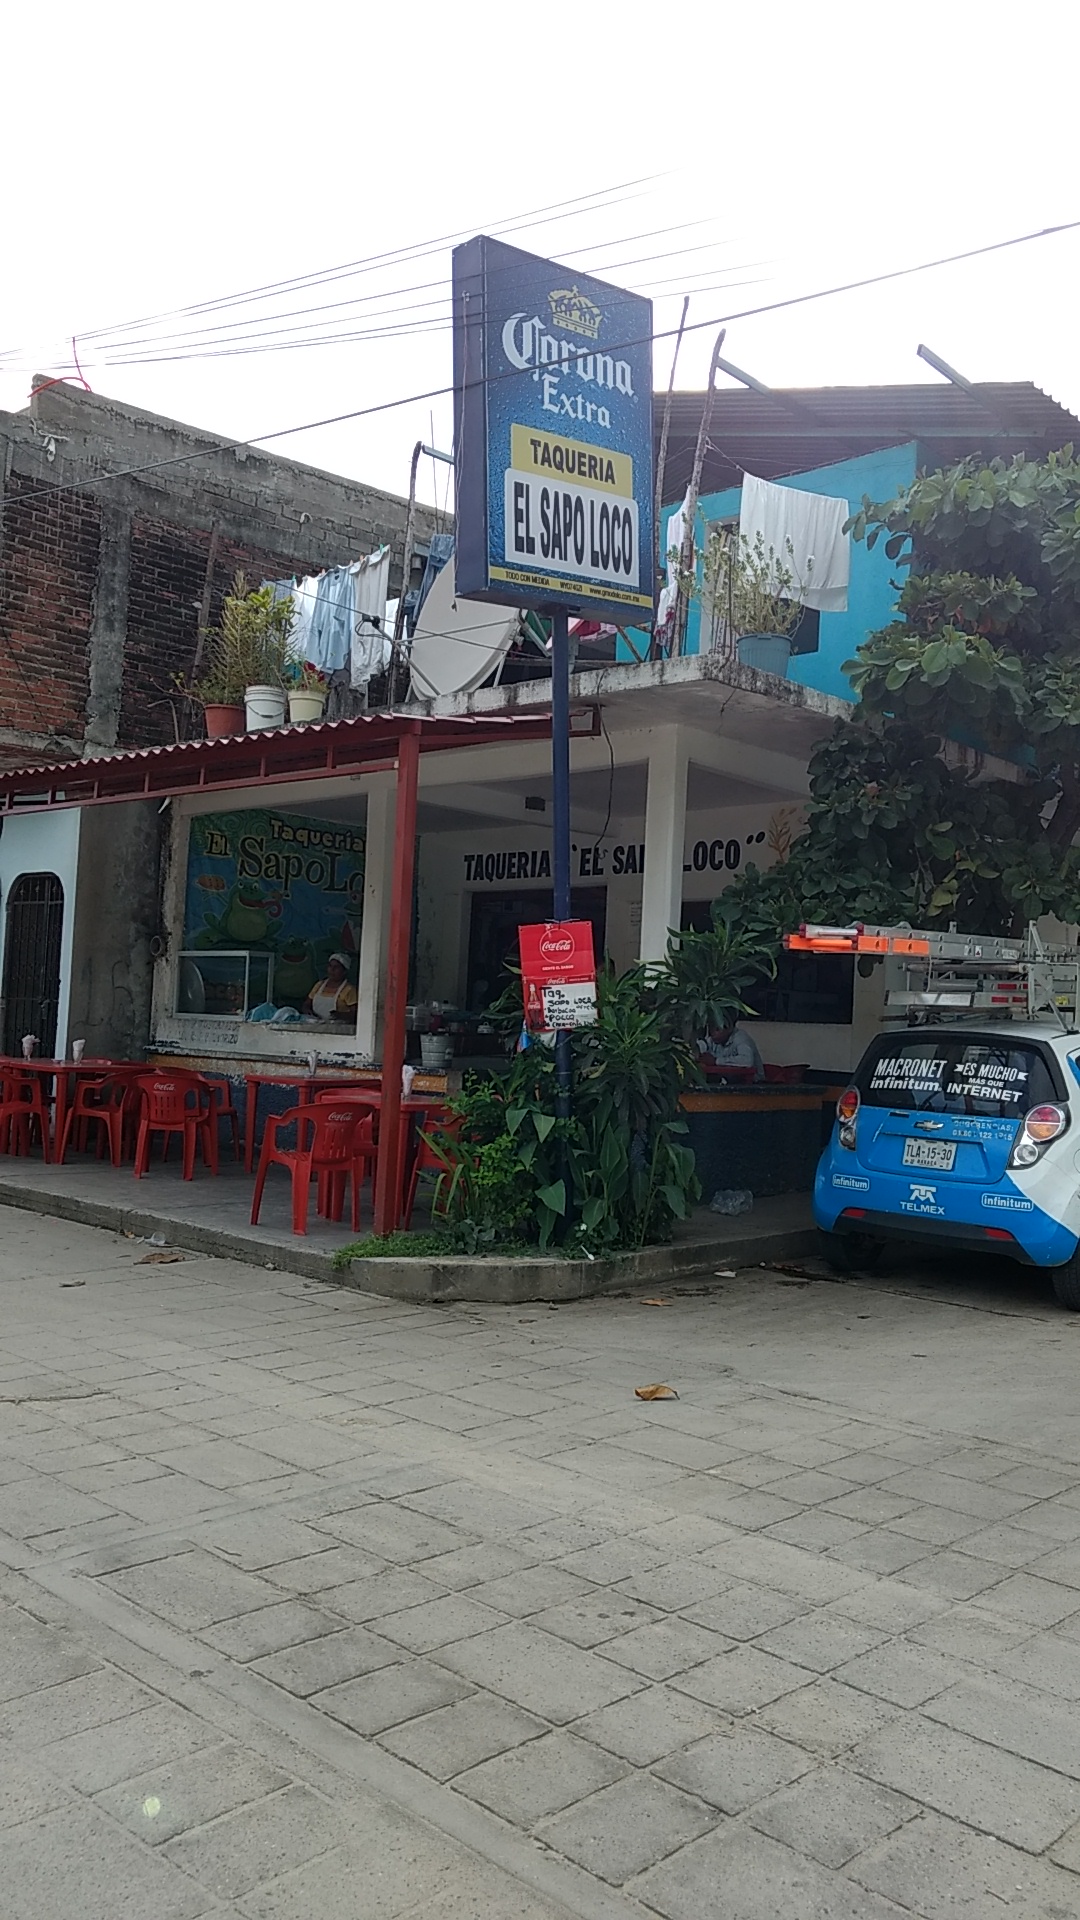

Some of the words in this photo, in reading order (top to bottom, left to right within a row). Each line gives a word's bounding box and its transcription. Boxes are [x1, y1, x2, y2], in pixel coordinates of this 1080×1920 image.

[501, 312, 634, 397] Corona
[542, 373, 611, 429] Extra
[530, 438, 616, 484] TAQUERIA
[514, 481, 535, 557] EL
[540, 487, 584, 566] SAPO
[590, 499, 633, 576] LOCO
[505, 571, 519, 581] TODO
[520, 573, 531, 582] CON
[531, 575, 550, 586] MEDIDA
[205, 831, 231, 857] El
[270, 818, 365, 853] Taquería
[464, 849, 551, 882] TAQUERIA
[873, 1058, 948, 1078] MACRONET
[962, 1062, 977, 1076] ES
[978, 1064, 1018, 1082] MUCHO
[946, 1082, 1023, 1102] INTERNET
[987, 1080, 1005, 1088] QUE
[906, 1144, 953, 1161] TLA-15-30
[833, 1175, 868, 1189] infinitum
[900, 1202, 945, 1216] TELMEX
[984, 1196, 1031, 1210] infinitum
